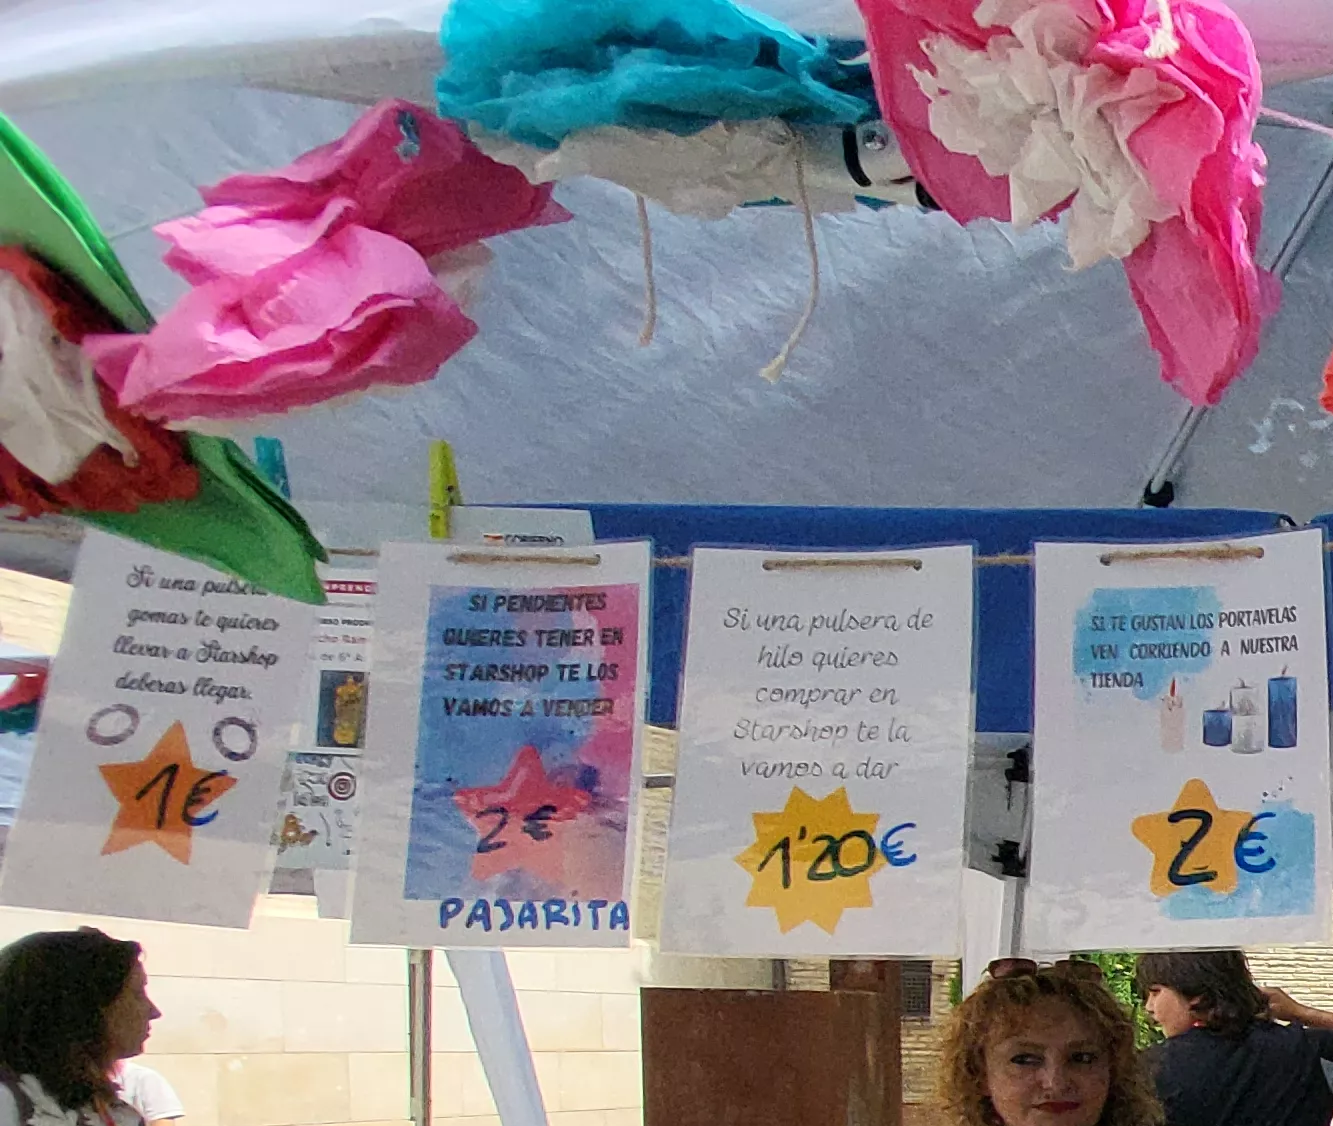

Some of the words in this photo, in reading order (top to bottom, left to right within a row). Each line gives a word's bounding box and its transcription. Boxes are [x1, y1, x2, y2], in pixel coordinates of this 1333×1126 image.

[126, 564, 154, 588] Si
[158, 576, 197, 592] una
[469, 593, 487, 613] SI
[492, 592, 607, 613] PENDIENTES
[126, 608, 188, 627] gomas
[194, 609, 213, 627] te
[216, 613, 280, 633] quieres
[723, 606, 748, 631] Si
[757, 611, 803, 632] una
[809, 608, 900, 637] pulsera
[907, 607, 934, 631] de
[1091, 615, 1106, 632] SI
[1110, 615, 1127, 632] TE
[1131, 613, 1185, 632] GUSTAN
[1188, 612, 1214, 630] LOS
[1218, 605, 1298, 628] PORTAVELAS
[442, 627, 529, 648] QUIERES
[536, 628, 594, 648] TENER
[601, 627, 624, 646] EN
[1090, 643, 1118, 660] VEN
[1129, 641, 1211, 660] CORRIENDO
[1220, 640, 1231, 657] A
[1240, 635, 1299, 656] NUESTRA
[113, 634, 171, 660] llevar
[176, 648, 190, 661] a
[195, 639, 279, 669] Starshop
[756, 644, 803, 668] hilo
[812, 646, 899, 674] quieres
[115, 670, 187, 694] deberas
[444, 663, 550, 682] STARSHOP
[556, 664, 580, 682] TE
[587, 663, 619, 681] LOS
[1091, 672, 1144, 689] TIENDA
[442, 697, 513, 718] VAMOS
[519, 699, 535, 717] A
[543, 698, 614, 718] VENDER
[756, 685, 862, 709] comprar
[868, 687, 899, 705] en
[733, 717, 848, 747] Starshop
[856, 720, 880, 742] te
[887, 719, 911, 743] la
[740, 760, 823, 780] vamos
[831, 761, 849, 780] a
[855, 754, 900, 780] dar
[439, 892, 630, 932] PAJARITA
